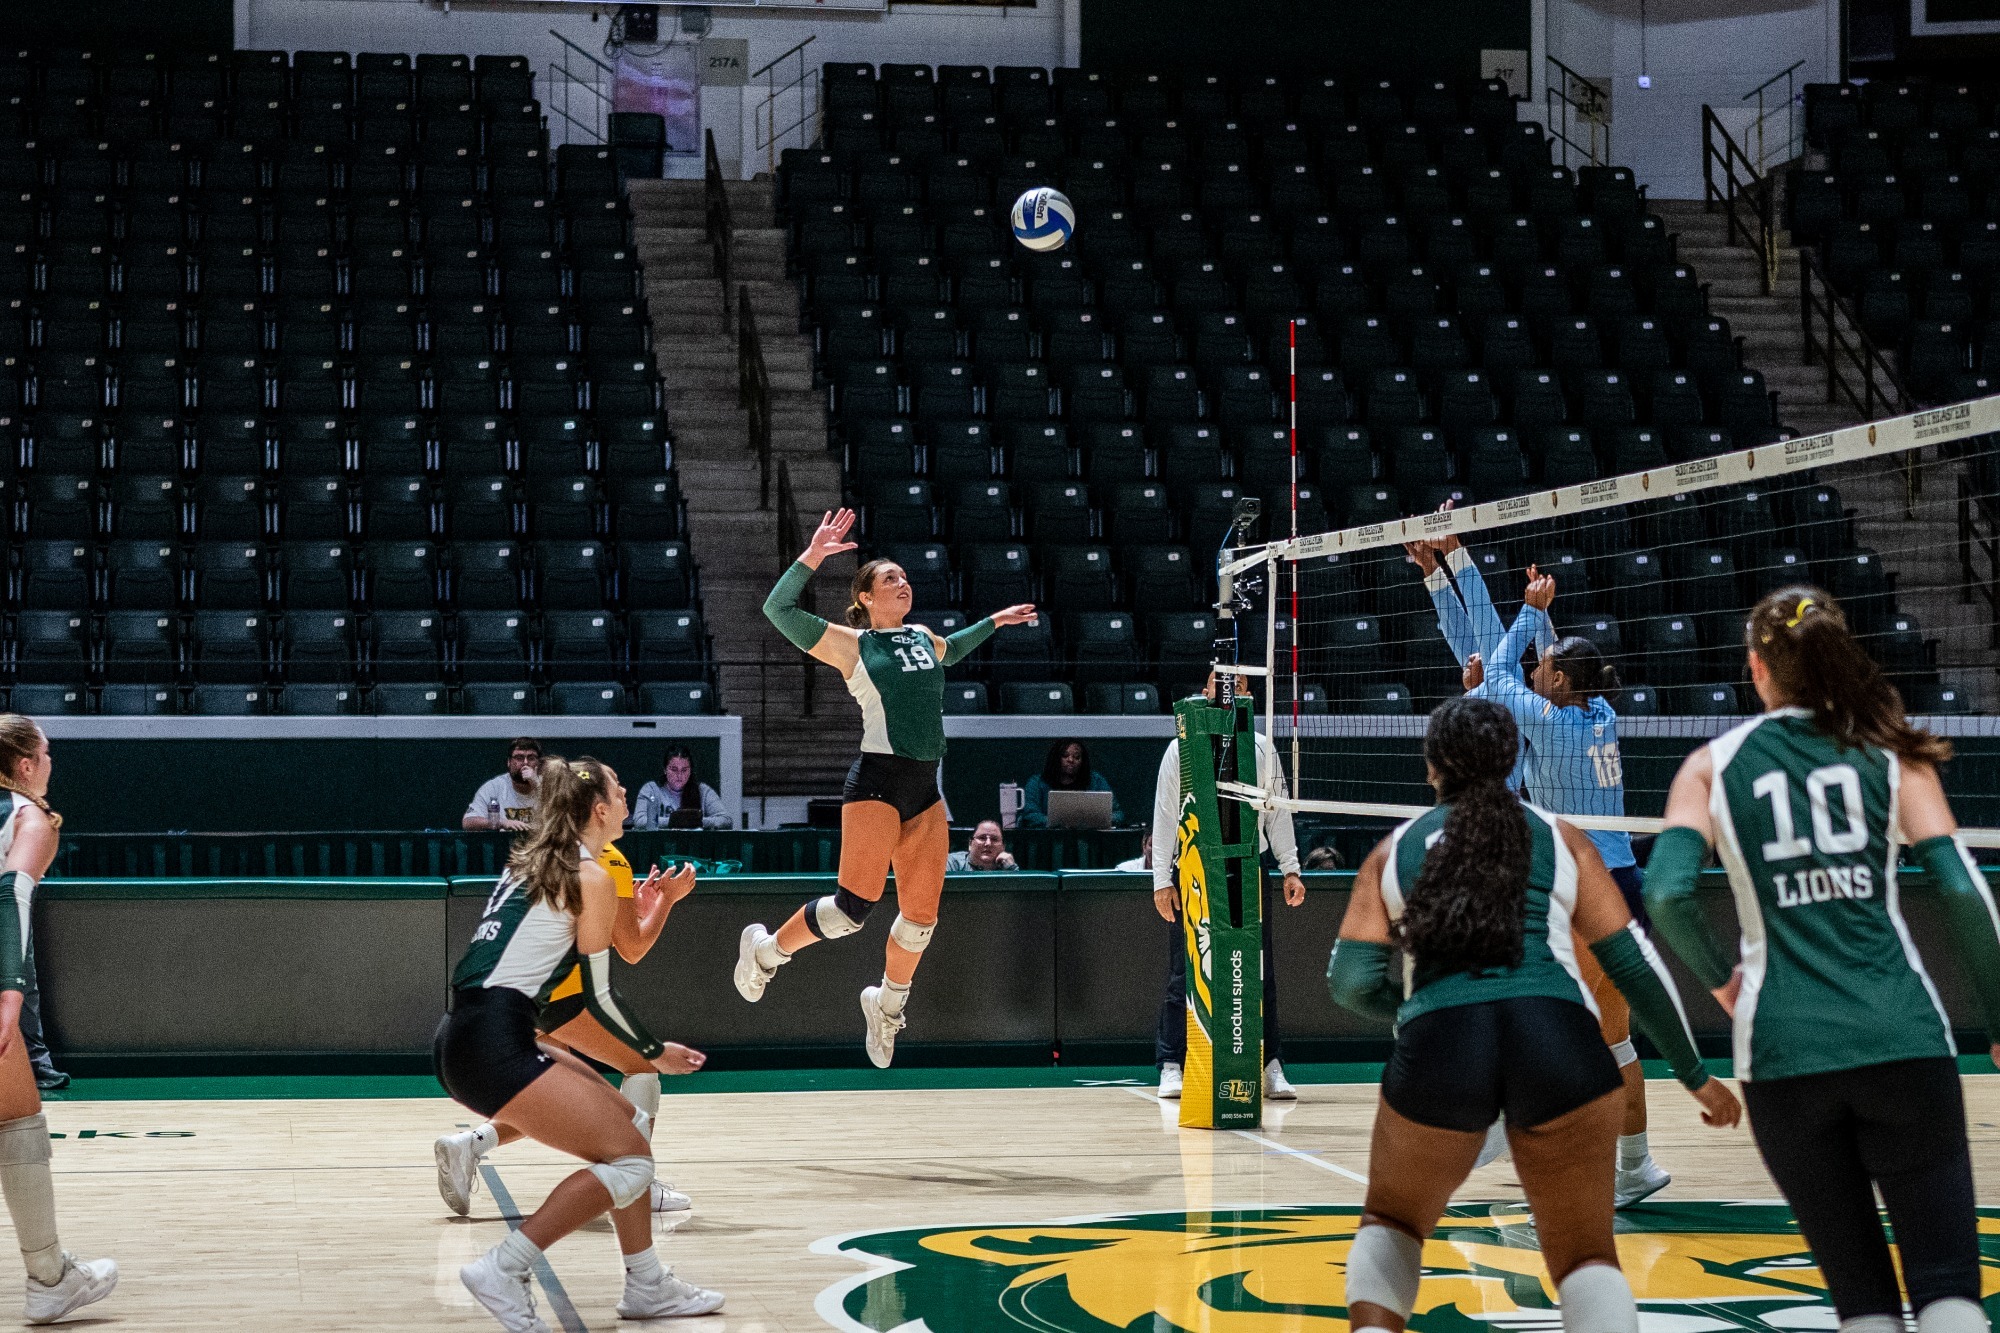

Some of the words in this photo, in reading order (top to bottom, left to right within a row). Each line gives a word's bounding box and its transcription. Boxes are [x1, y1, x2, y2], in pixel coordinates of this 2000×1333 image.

[709, 57, 740, 69] 217A
[894, 645, 935, 672] 19
[1753, 764, 1869, 862] 10
[1772, 864, 1874, 908] LIONS
[1230, 950, 1242, 995] sports
[1230, 996, 1243, 1054] imports
[1219, 1080, 1256, 1100] SLU
